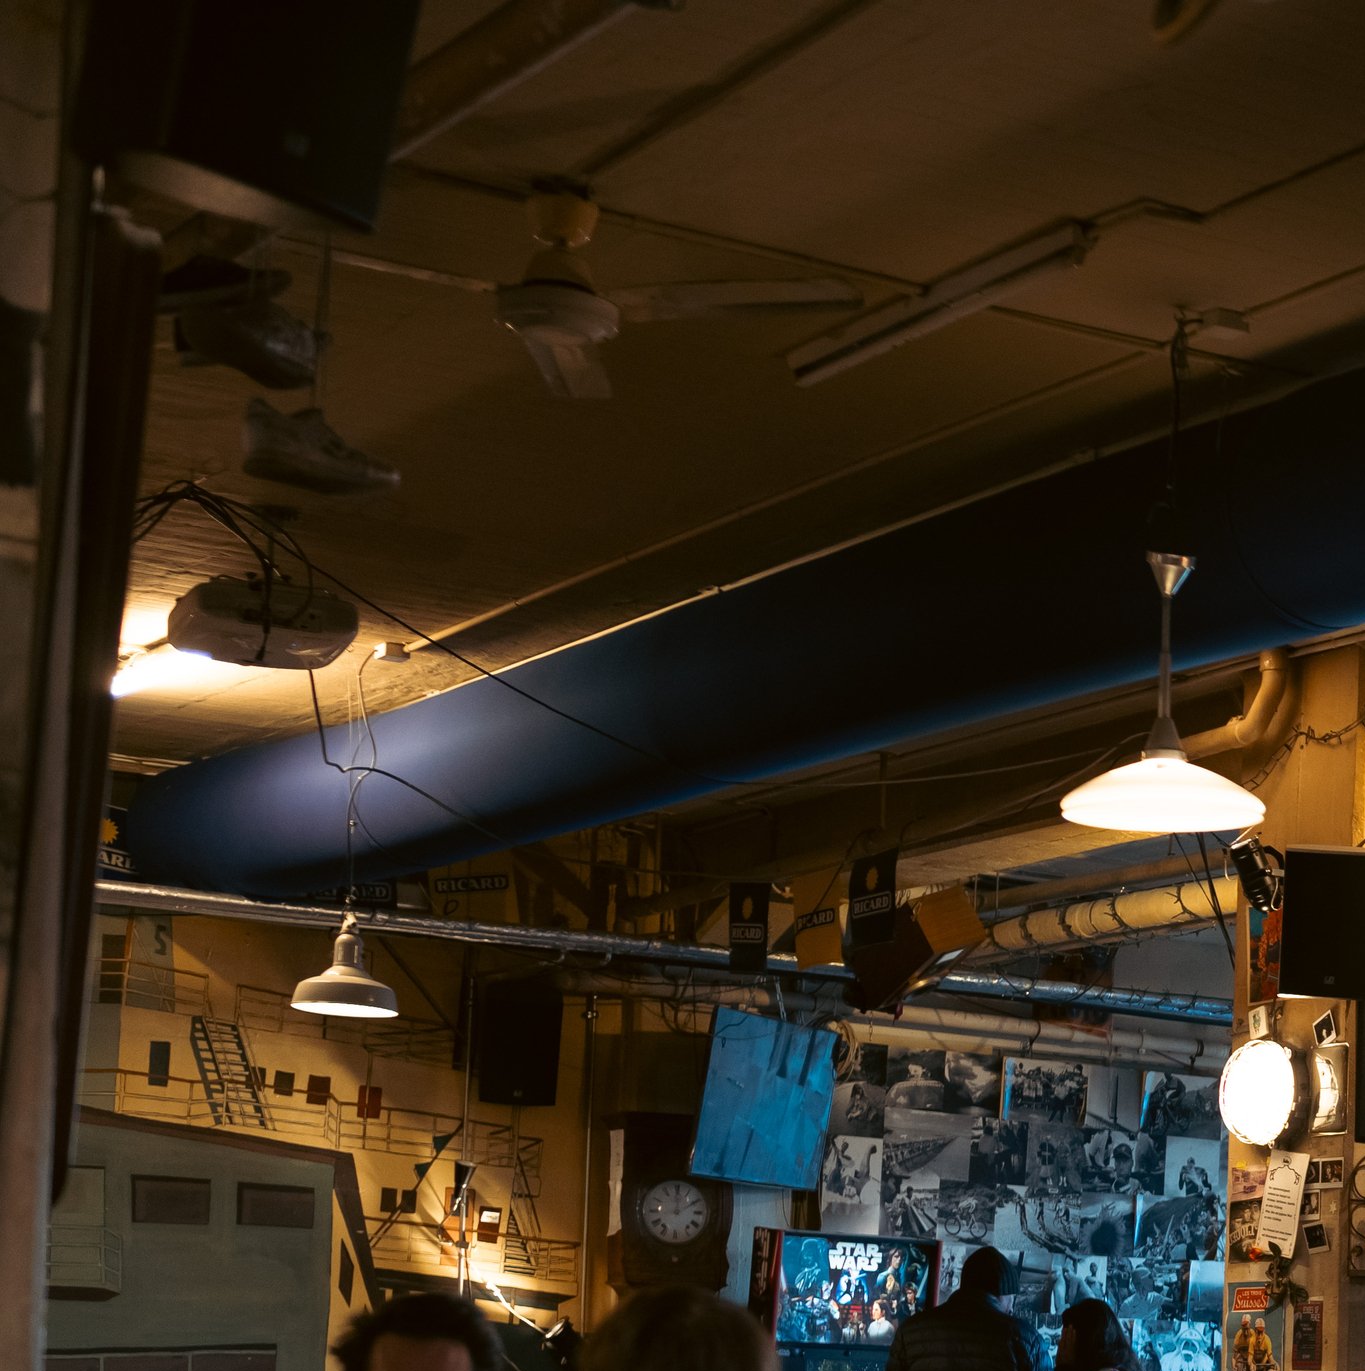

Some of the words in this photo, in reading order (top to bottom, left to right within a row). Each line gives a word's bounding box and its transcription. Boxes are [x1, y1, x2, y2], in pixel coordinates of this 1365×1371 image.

[436, 876, 508, 893] RICARD
[853, 896, 890, 915] RICARD
[732, 926, 762, 939] RICARD
[829, 1241, 883, 1258] STAR
[829, 1254, 883, 1272] WARS
